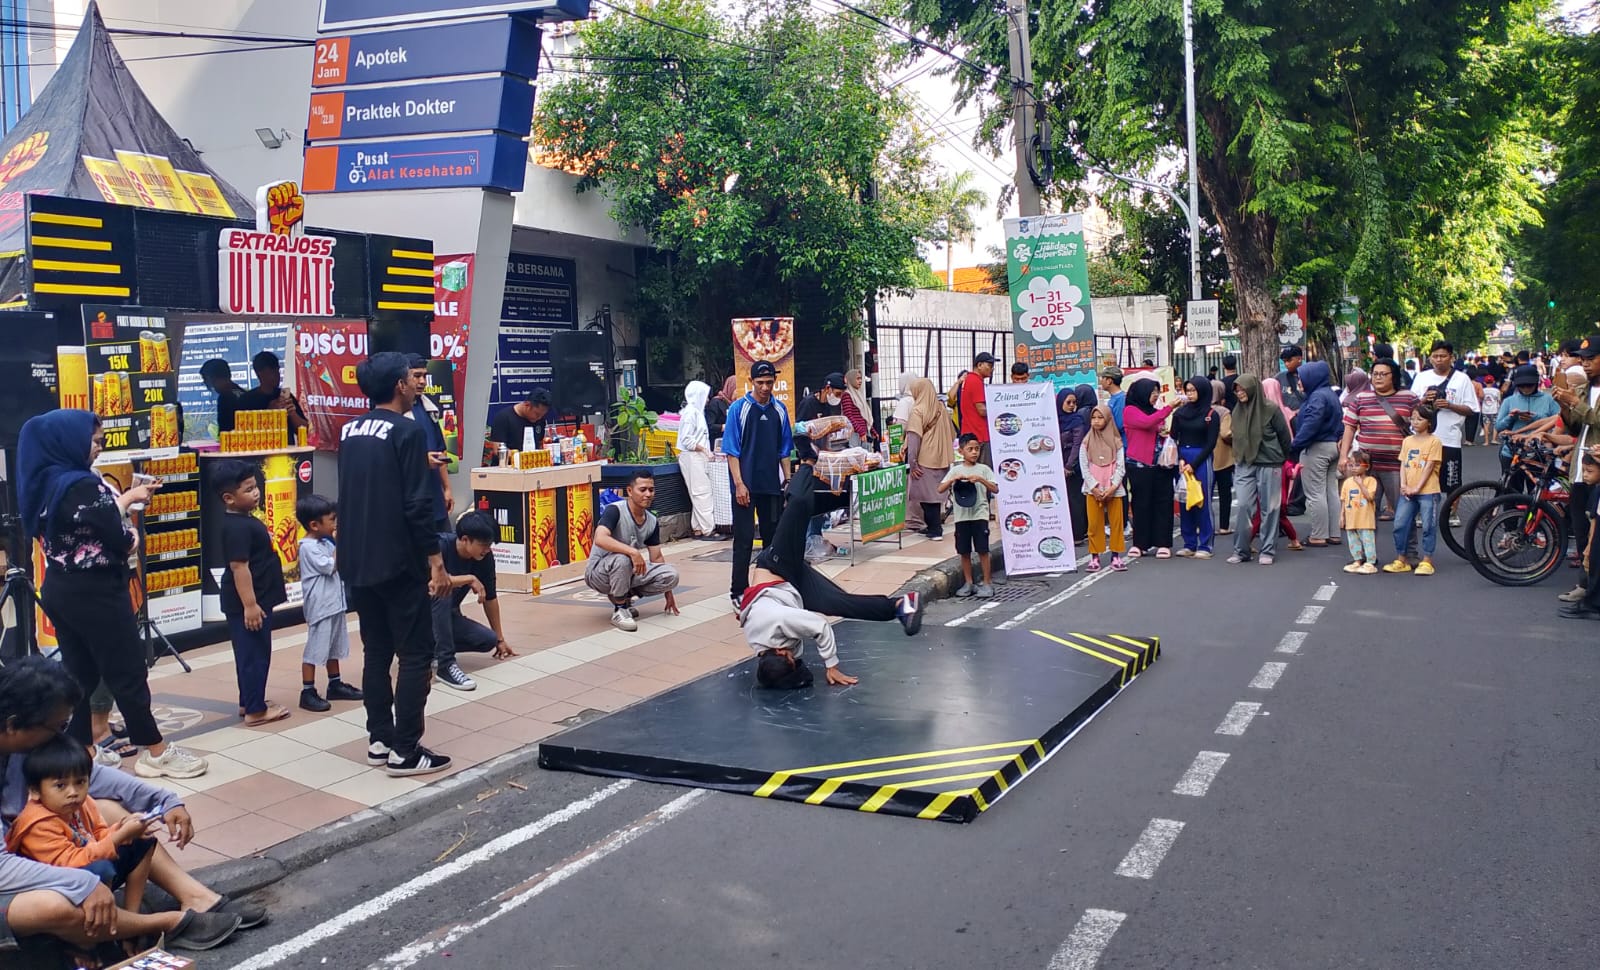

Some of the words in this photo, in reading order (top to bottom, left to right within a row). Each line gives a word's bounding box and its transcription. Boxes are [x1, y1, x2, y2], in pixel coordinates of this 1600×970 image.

[317, 43, 339, 64] 24
[355, 47, 407, 69] Apotek
[317, 67, 340, 79] Jam
[346, 102, 401, 122] Praktek
[405, 99, 456, 117] Dokter
[357, 152, 389, 166] Pusat
[367, 168, 395, 180] Alat
[400, 164, 473, 178] Kesehatan
[229, 231, 332, 256] EXTRAJOSS
[517, 263, 565, 278] BERSAMA
[229, 251, 334, 315] ULTIMATE
[434, 301, 458, 316] ALE
[1047, 301, 1072, 314] DES
[1031, 314, 1065, 328] 2025
[300, 333, 346, 355] DISC
[108, 354, 130, 370] 15K
[144, 388, 164, 403] 20K
[307, 394, 340, 407] SETIAP
[341, 396, 364, 409] HARI
[341, 419, 394, 441] FLAVE
[105, 431, 128, 448] 20K
[862, 469, 903, 496] LUMPUR
[862, 498, 883, 514] BAKAR
[884, 493, 904, 510] JUMBO
